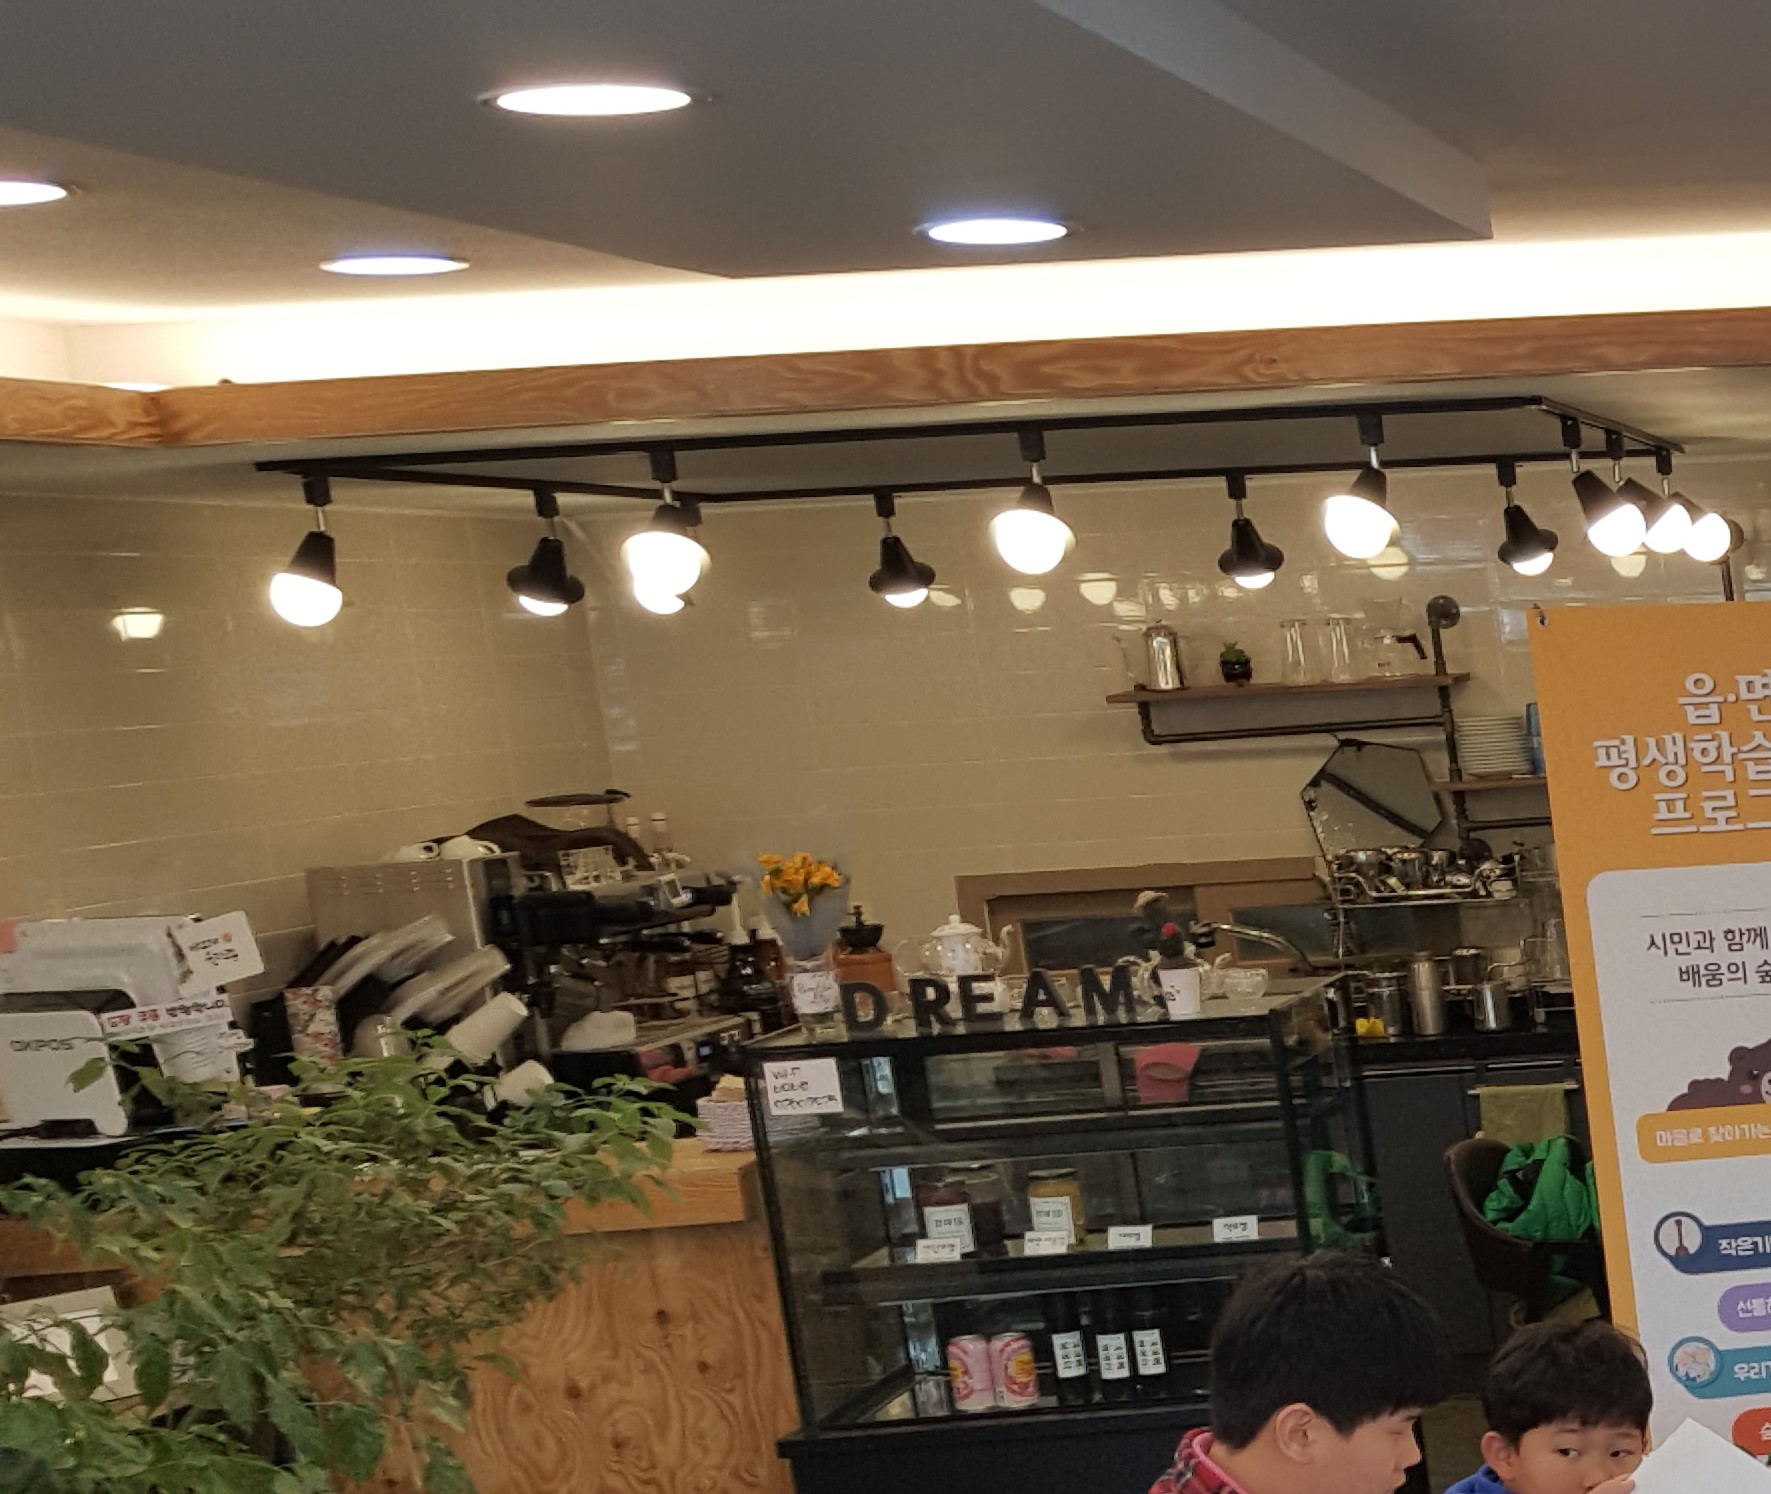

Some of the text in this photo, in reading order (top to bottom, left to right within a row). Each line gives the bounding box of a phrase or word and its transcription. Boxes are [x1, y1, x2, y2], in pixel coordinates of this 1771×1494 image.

[1646, 929, 1716, 957] 시민과
[1724, 925, 1768, 953] 함께
[1678, 960, 1748, 988] 배움의
